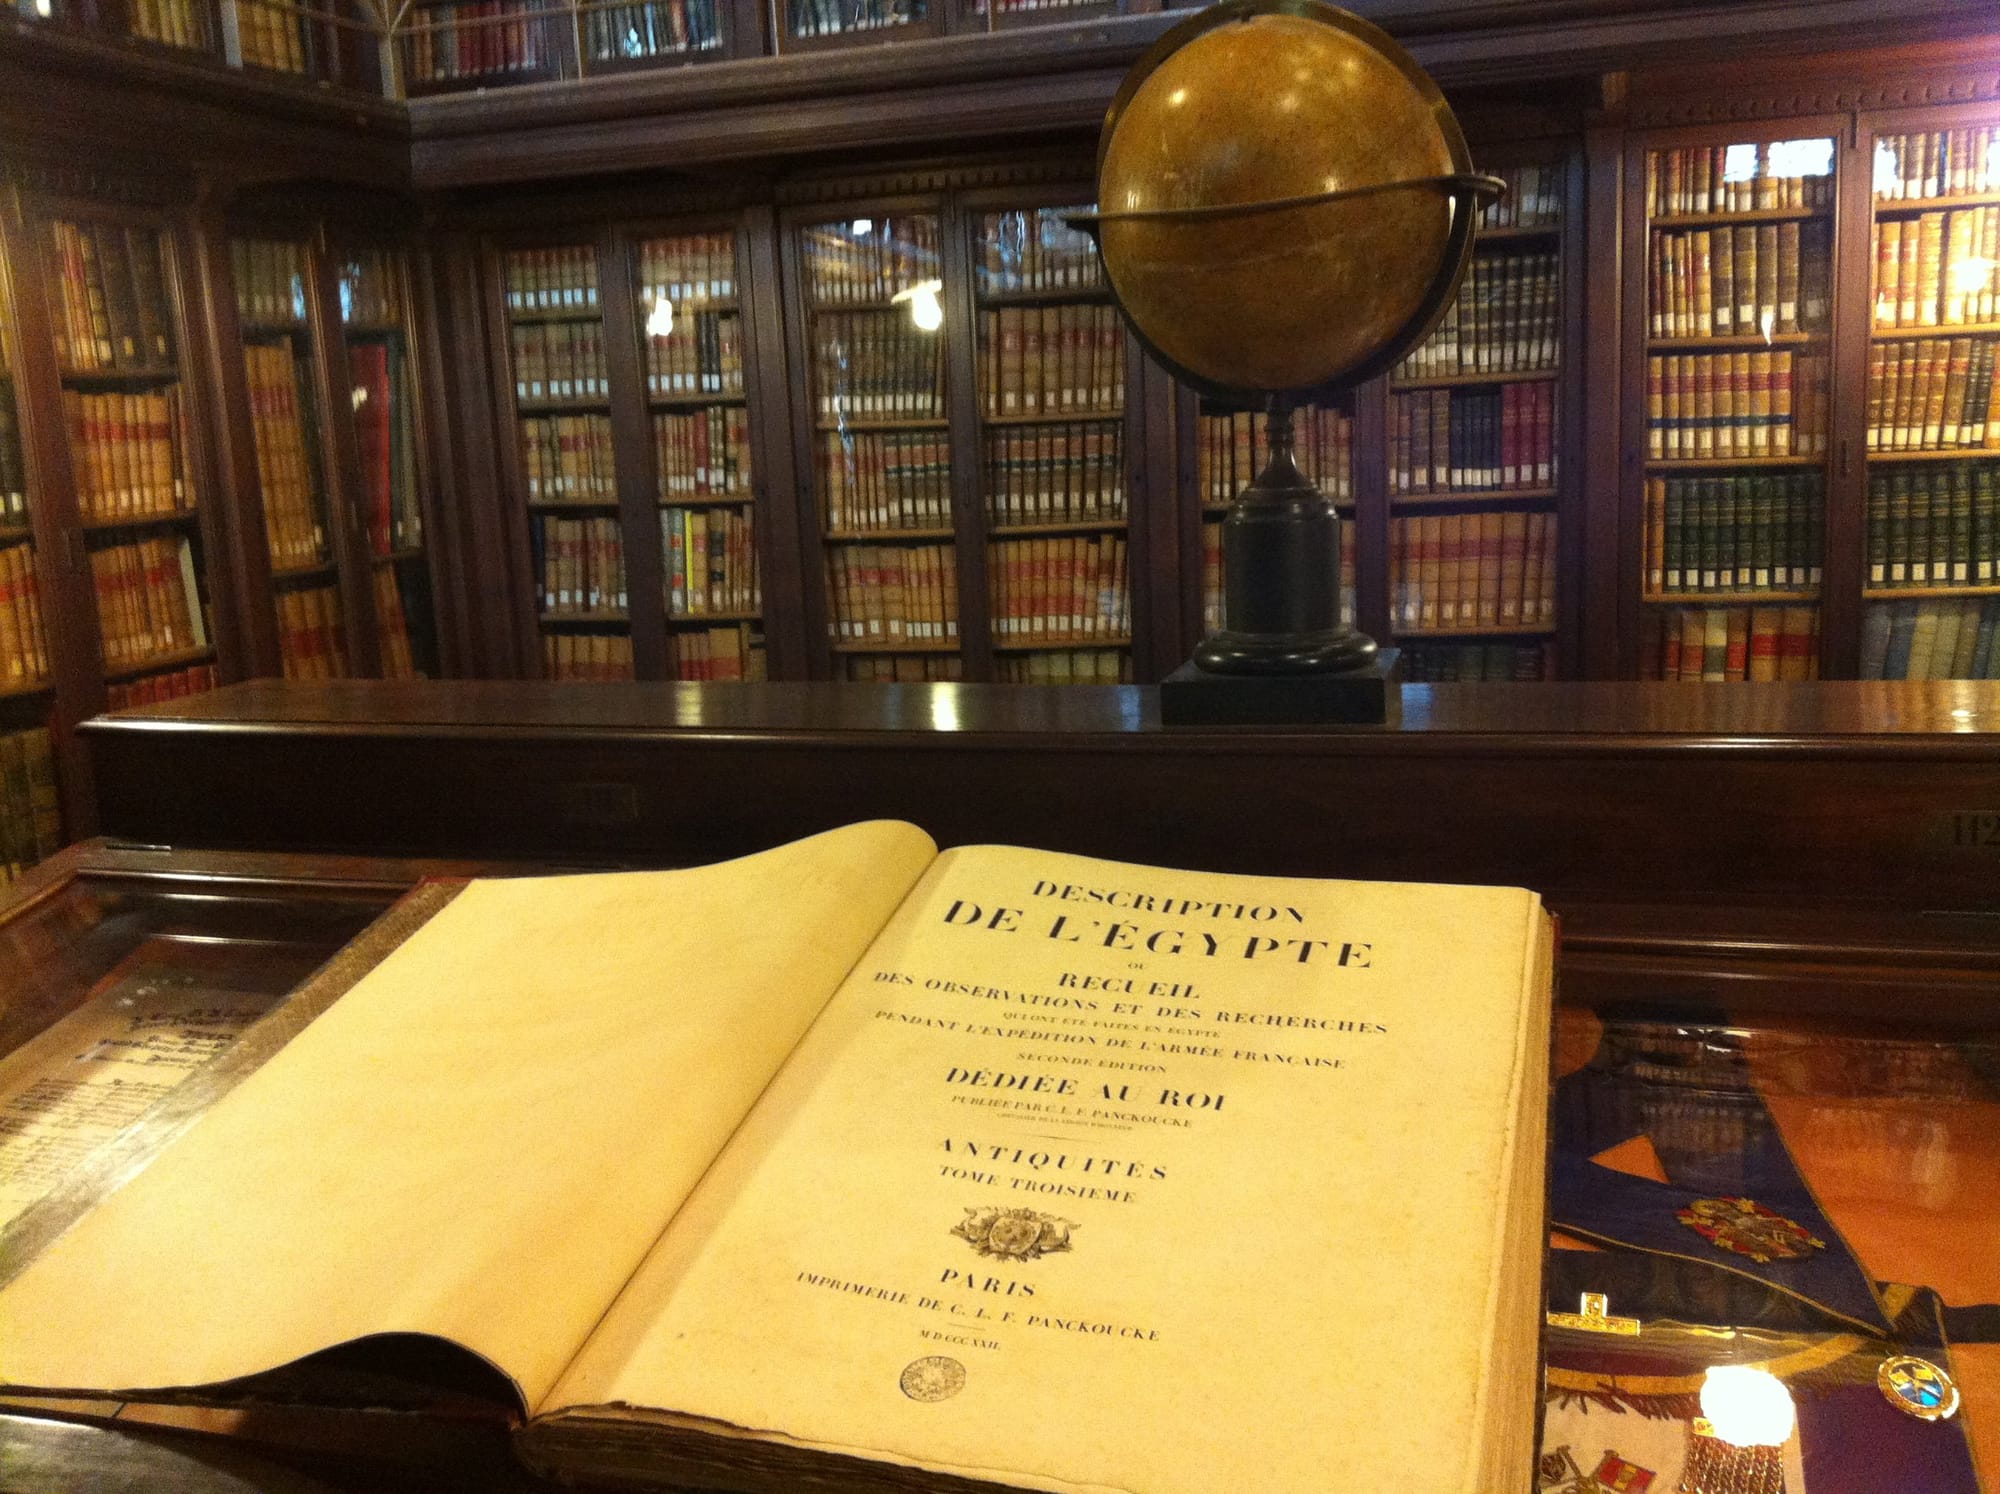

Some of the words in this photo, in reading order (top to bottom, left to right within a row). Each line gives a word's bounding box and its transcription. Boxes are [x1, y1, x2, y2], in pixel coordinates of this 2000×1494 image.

[1033, 880, 1304, 923] DESCRIPTION
[943, 899, 1024, 932] DE
[1049, 915, 1372, 968] L'ÉGYPTE
[874, 972, 914, 985] DES
[925, 979, 1098, 1010] OBSERVATIONS
[1112, 1003, 1143, 1015] ET
[1157, 1007, 1200, 1019] DES
[1216, 1011, 1388, 1033] RECHERCHES
[1058, 972, 1200, 999] RECUEIL
[875, 1010, 960, 1030] PENDANT
[1106, 1038, 1132, 1048] DE
[1017, 1053, 1092, 1066] SECONDE
[946, 1067, 1079, 1096] DÉDIÉE
[1092, 1083, 1141, 1102] AU
[1159, 1089, 1225, 1111] ROI
[940, 1164, 1000, 1186] TOME
[940, 1268, 1036, 1297] PARIS
[797, 1271, 909, 1304] IMPRIMERIE
[918, 1296, 942, 1311] DE
[1028, 1315, 1160, 1341] PANCKOUCKE
